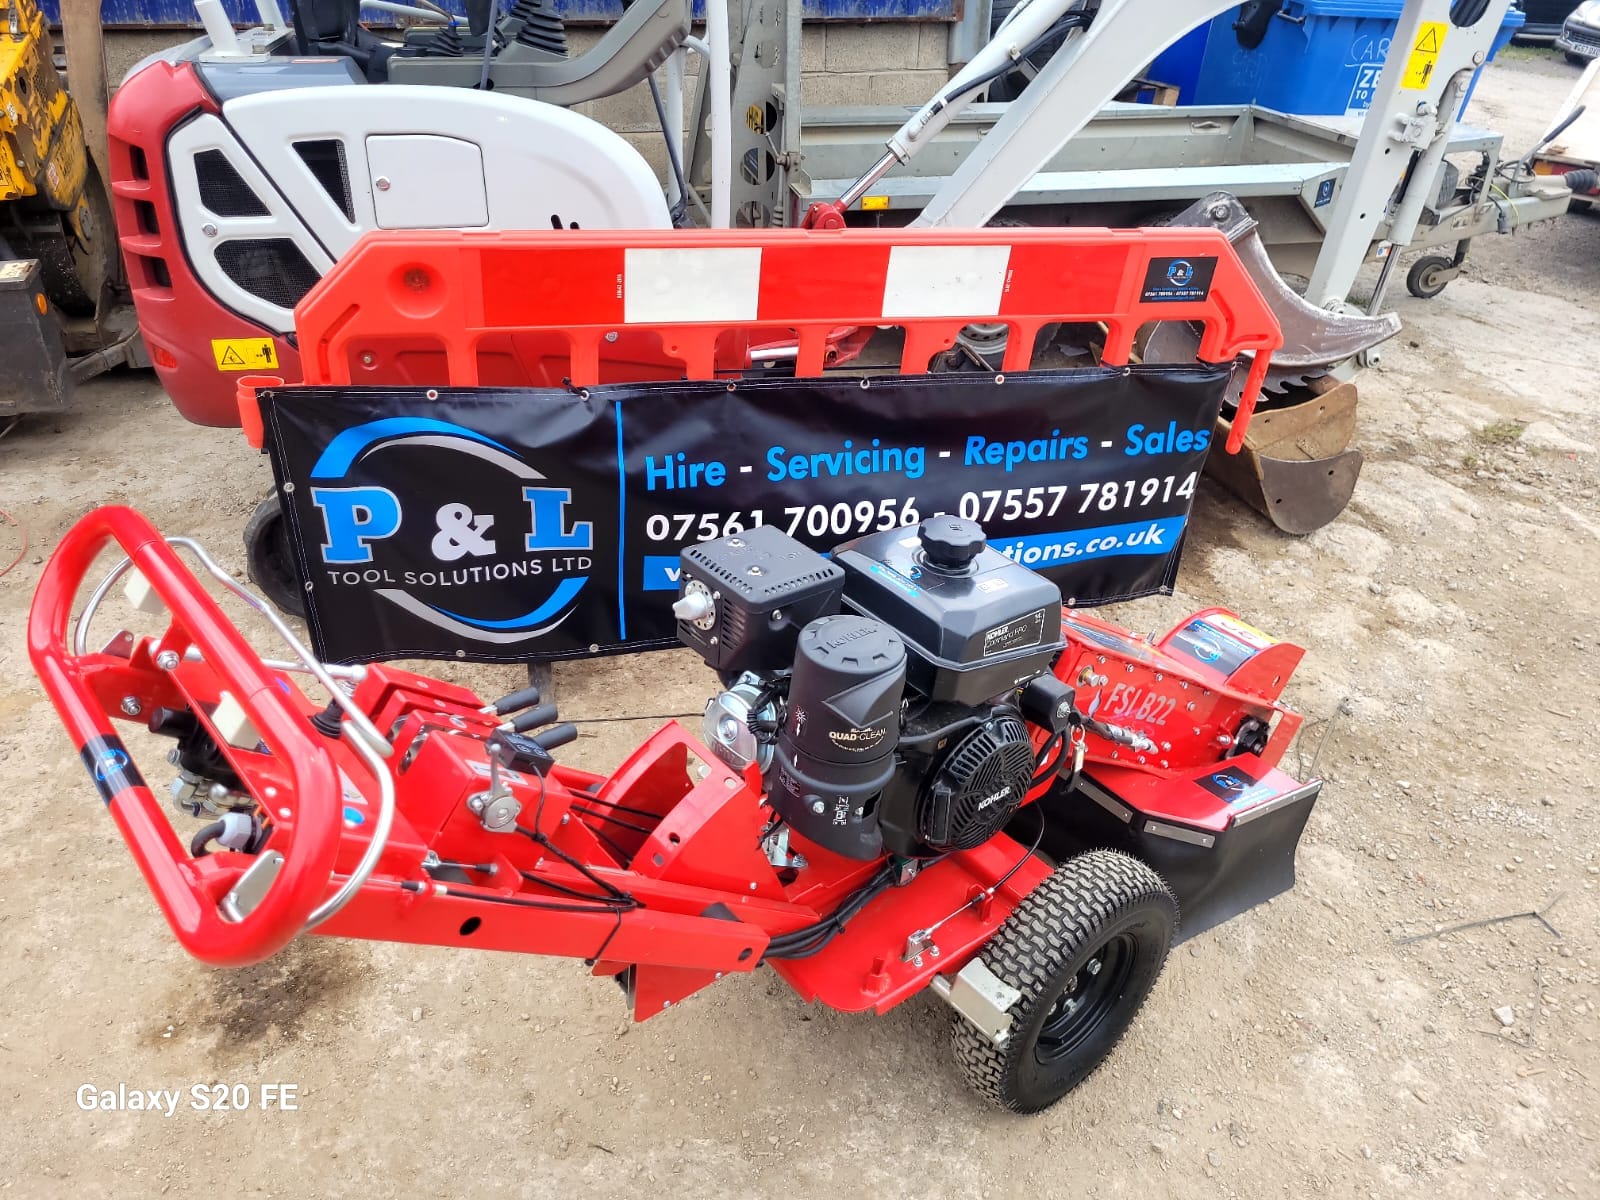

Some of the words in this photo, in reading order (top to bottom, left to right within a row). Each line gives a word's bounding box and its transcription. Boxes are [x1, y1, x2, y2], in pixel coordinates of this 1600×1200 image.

[1351, 34, 1392, 61] CAR
[1359, 69, 1383, 89] ZE
[1355, 90, 1368, 99] TO
[645, 451, 727, 491] Hire
[766, 439, 925, 482] Servicing
[964, 428, 1088, 472] Repairs
[1125, 421, 1211, 456] Sales
[646, 509, 764, 541] 07561
[784, 496, 921, 538] 700956
[959, 485, 1068, 522] 07557
[1078, 471, 1198, 514] 781914
[310, 486, 402, 564] P
[431, 503, 496, 561] &
[522, 486, 593, 552] L
[998, 523, 1166, 564] tions.co.uk
[327, 569, 396, 585] TOOL
[404, 558, 543, 586] SOLUTIONS
[552, 556, 592, 573] LTD
[986, 626, 1009, 641] KOHLER
[1136, 692, 1177, 726] B22
[978, 786, 1011, 811] KOHLER
